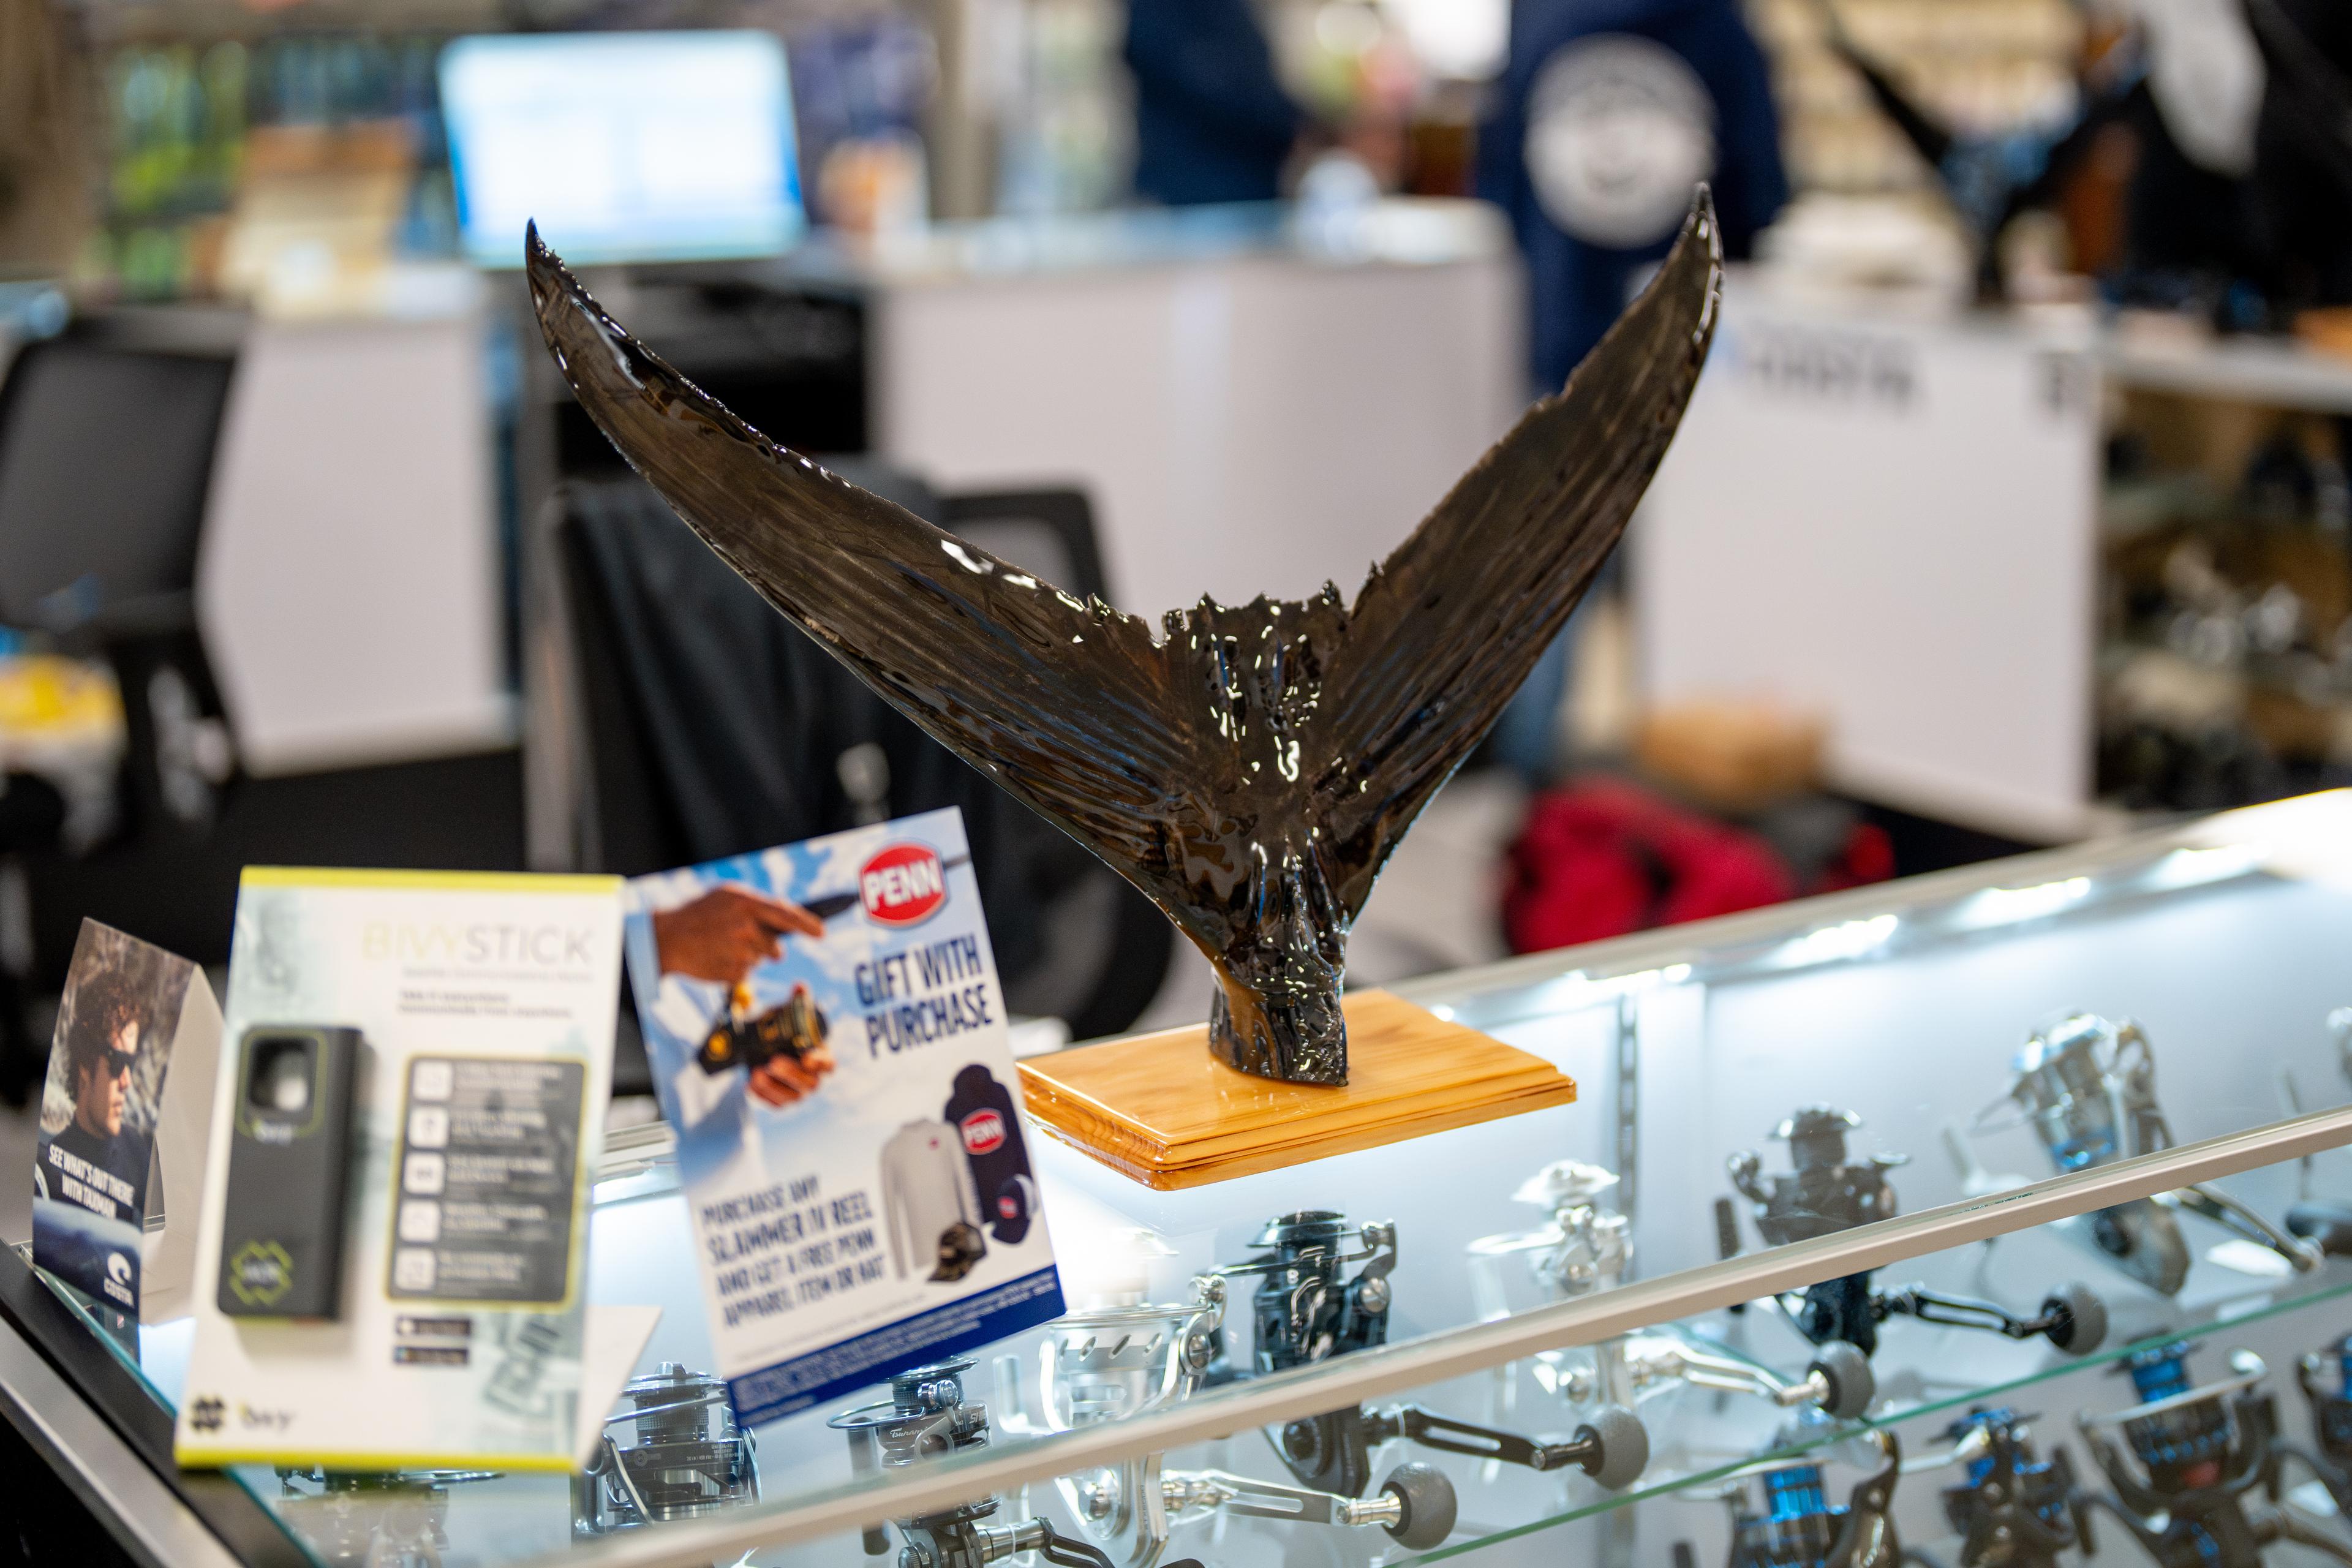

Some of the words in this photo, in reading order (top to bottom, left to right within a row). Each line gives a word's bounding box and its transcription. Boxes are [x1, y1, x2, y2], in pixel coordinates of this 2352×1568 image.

[864, 858, 943, 912] PENN
[855, 953, 911, 1006] GIFT
[916, 933, 982, 989] WITH
[864, 984, 993, 1060] PURCHASE
[964, 1118, 1005, 1147] PENN
[49, 1143, 63, 1169] SEE
[63, 1151, 92, 1185] WHAT'S
[92, 1165, 109, 1194] OUT
[108, 1174, 134, 1208] THERE
[62, 1172, 83, 1205] WITH
[704, 1186, 783, 1224] PURCHASE
[708, 1213, 803, 1263] SLAMMER
[831, 1191, 873, 1226] REEL
[717, 1268, 750, 1296] AND
[799, 1240, 834, 1272] FREE
[890, 1427, 928, 1438] Tsunam
